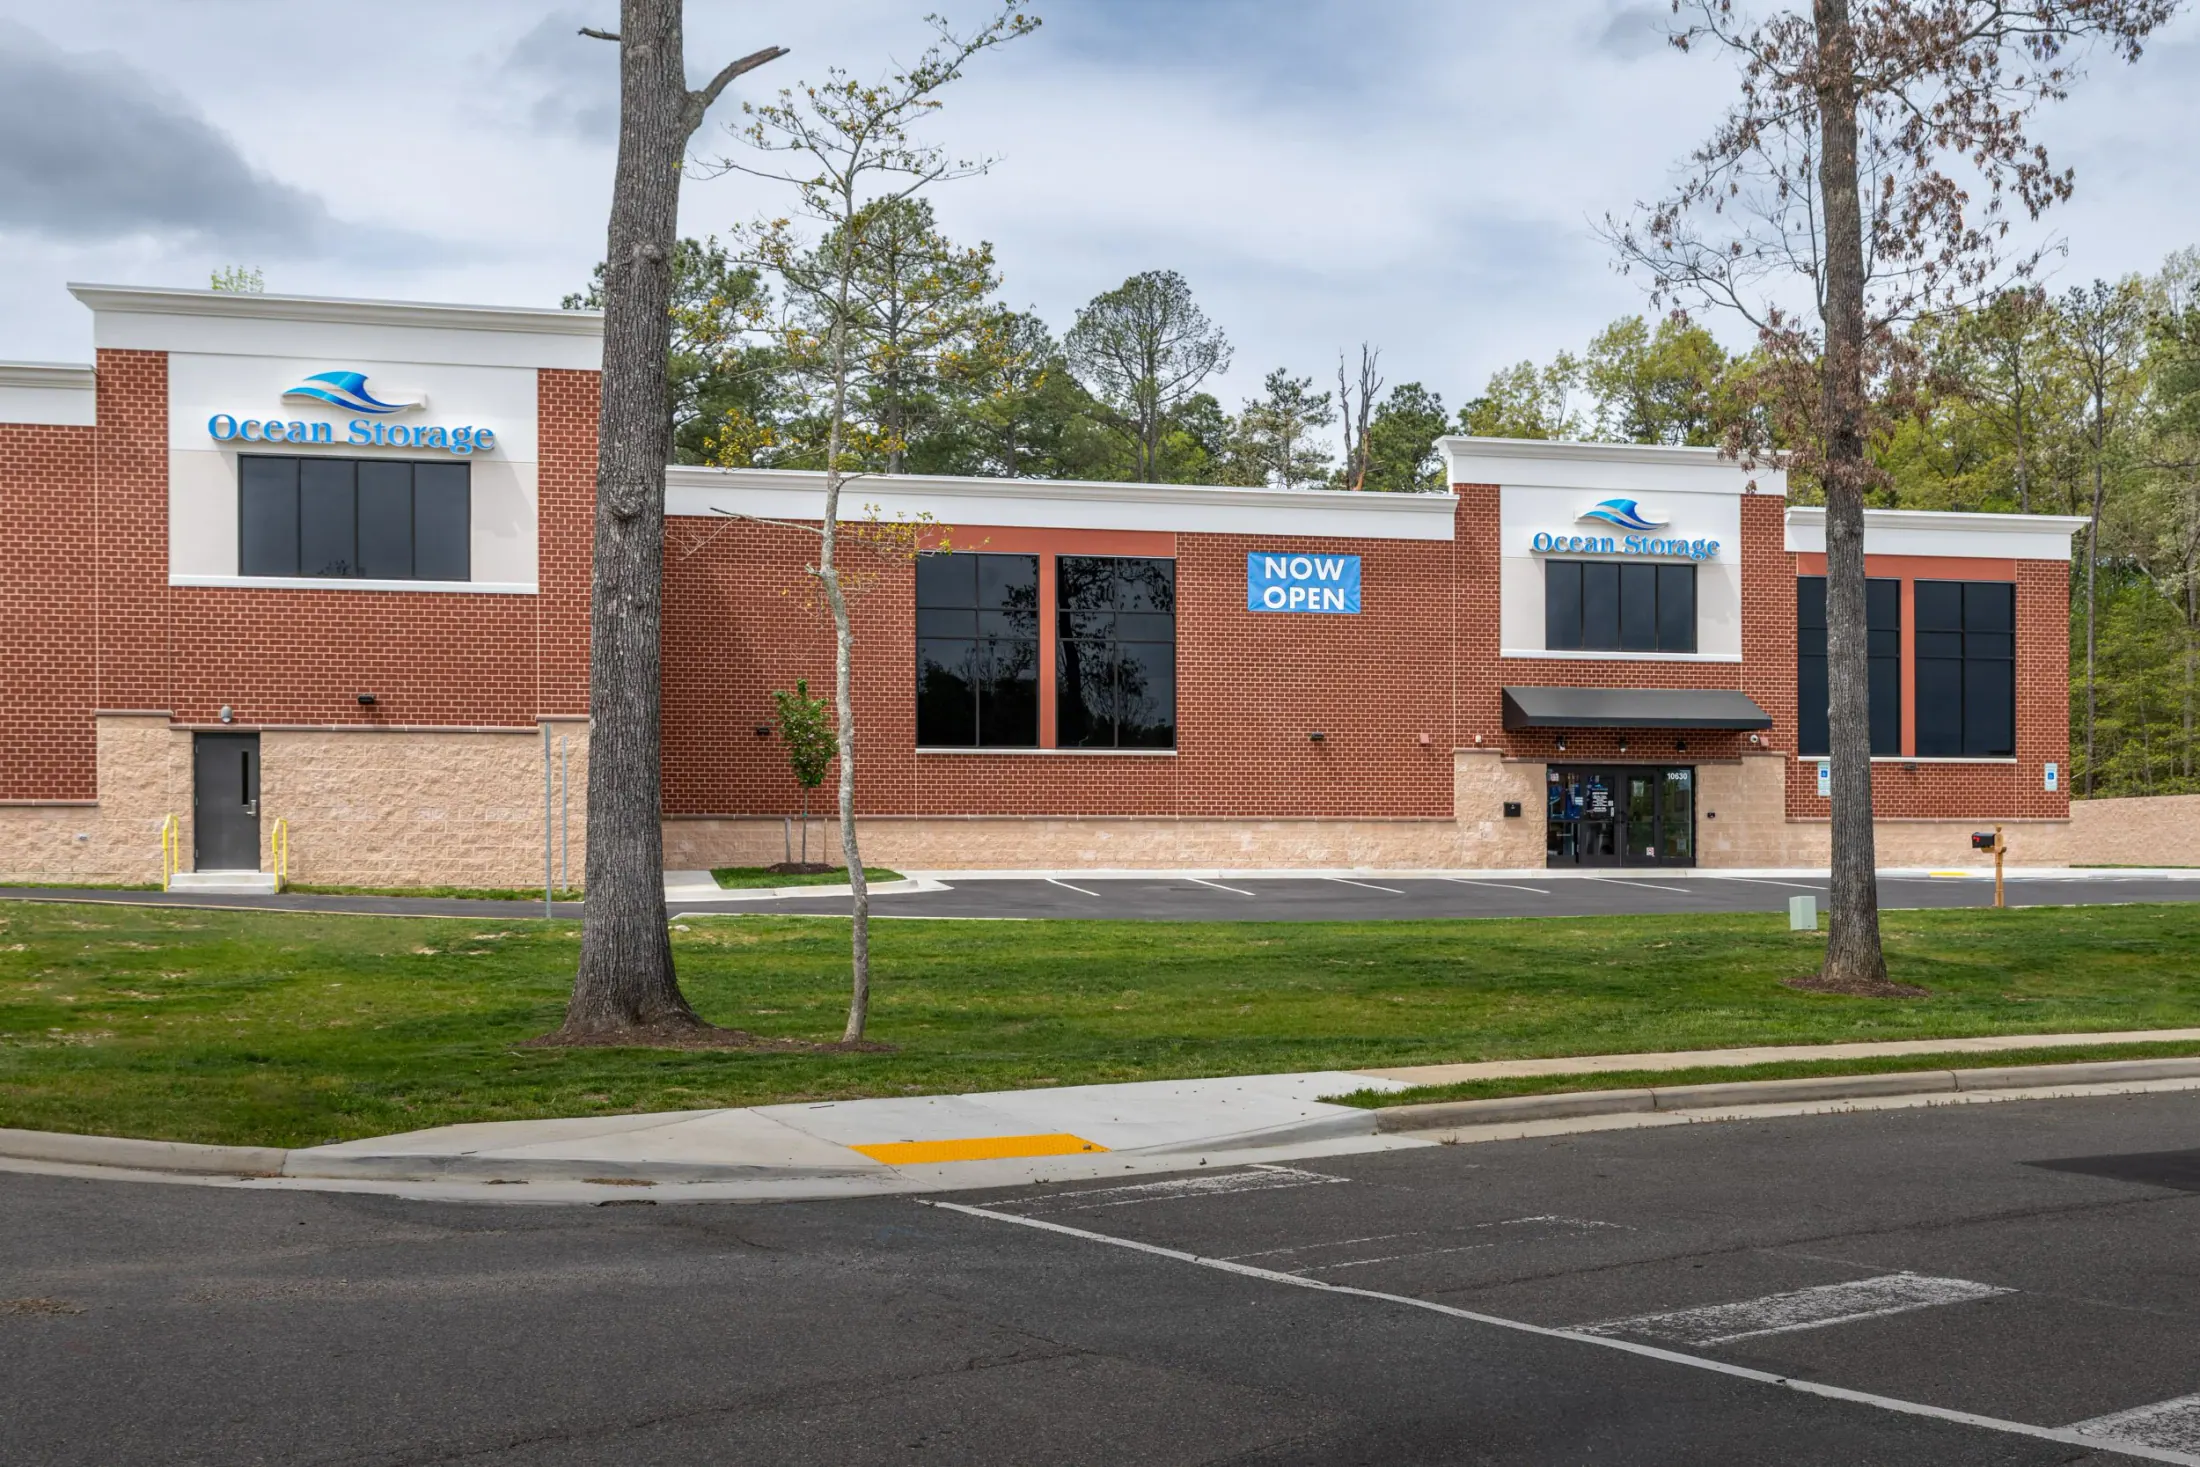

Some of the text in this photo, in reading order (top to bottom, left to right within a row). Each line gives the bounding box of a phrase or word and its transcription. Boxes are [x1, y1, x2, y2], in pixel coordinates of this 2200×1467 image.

[208, 413, 496, 454] Ocean Storage
[1532, 532, 1721, 561] Ocean Storage
[1264, 556, 1345, 581] NOW
[1263, 586, 1345, 610] OPEN
[1666, 772, 1688, 780] 10630
